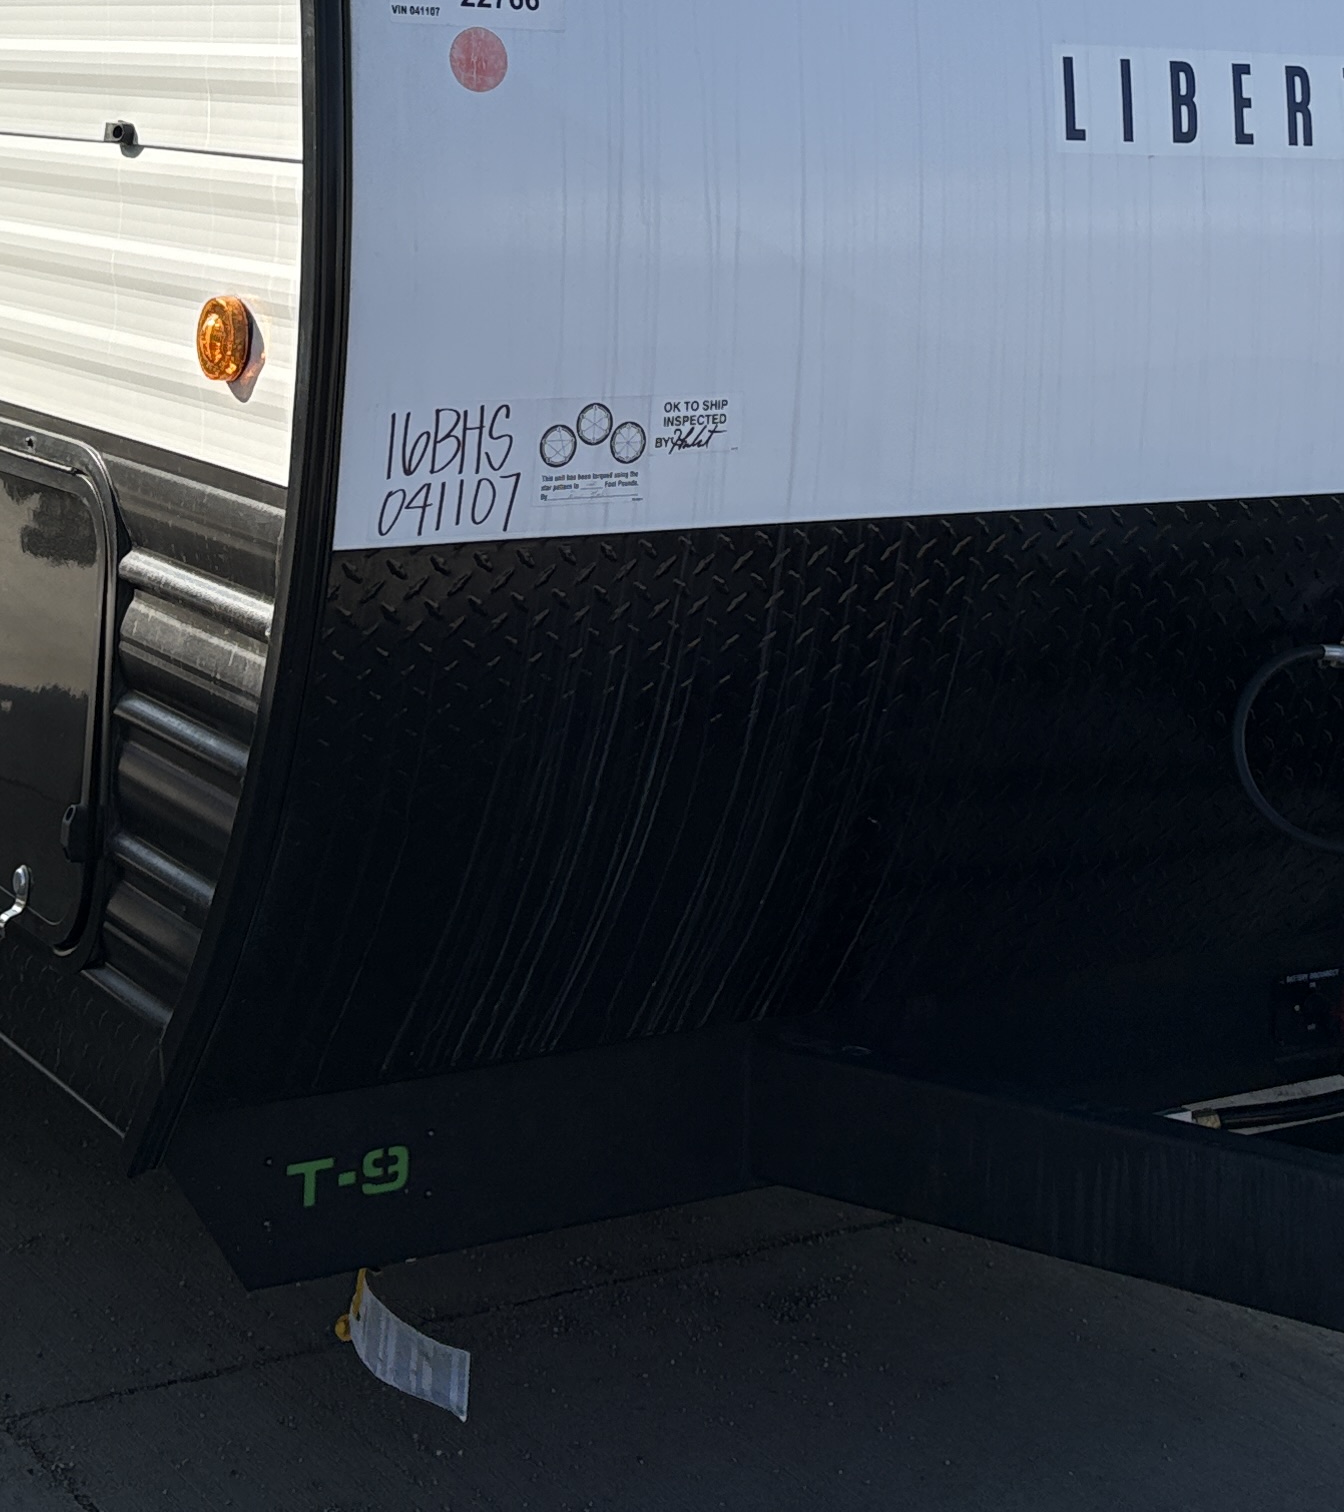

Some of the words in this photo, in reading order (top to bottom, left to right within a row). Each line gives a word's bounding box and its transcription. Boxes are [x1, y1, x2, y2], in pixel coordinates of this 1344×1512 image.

[391, 4, 407, 15] VIN
[409, 5, 440, 17] 041107
[663, 413, 727, 427] INSPECTED
[664, 401, 681, 413] OK
[684, 400, 699, 412] TO
[702, 399, 728, 411] SHIP
[386, 404, 513, 480] 16BHS
[377, 472, 521, 537] 041107
[286, 1145, 409, 1208] T-9
